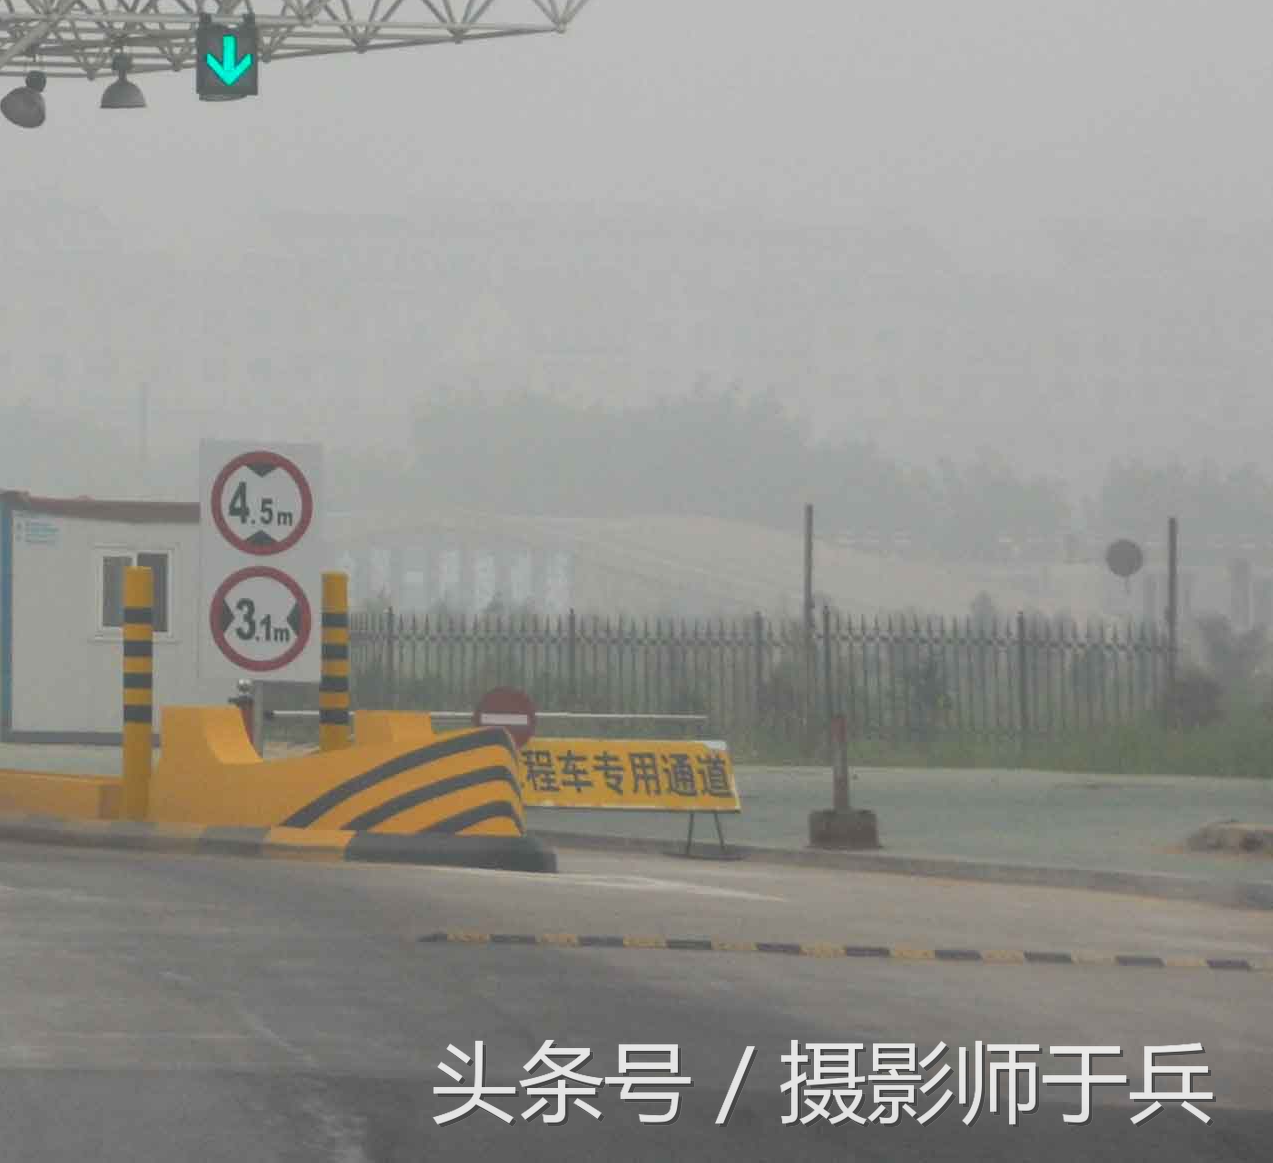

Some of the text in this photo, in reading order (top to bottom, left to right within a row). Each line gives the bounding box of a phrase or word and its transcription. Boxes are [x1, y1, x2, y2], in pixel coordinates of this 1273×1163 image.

[228, 481, 293, 526] 4.5m
[235, 598, 290, 642] 3.1m
[519, 749, 734, 797] 程车专用通道
